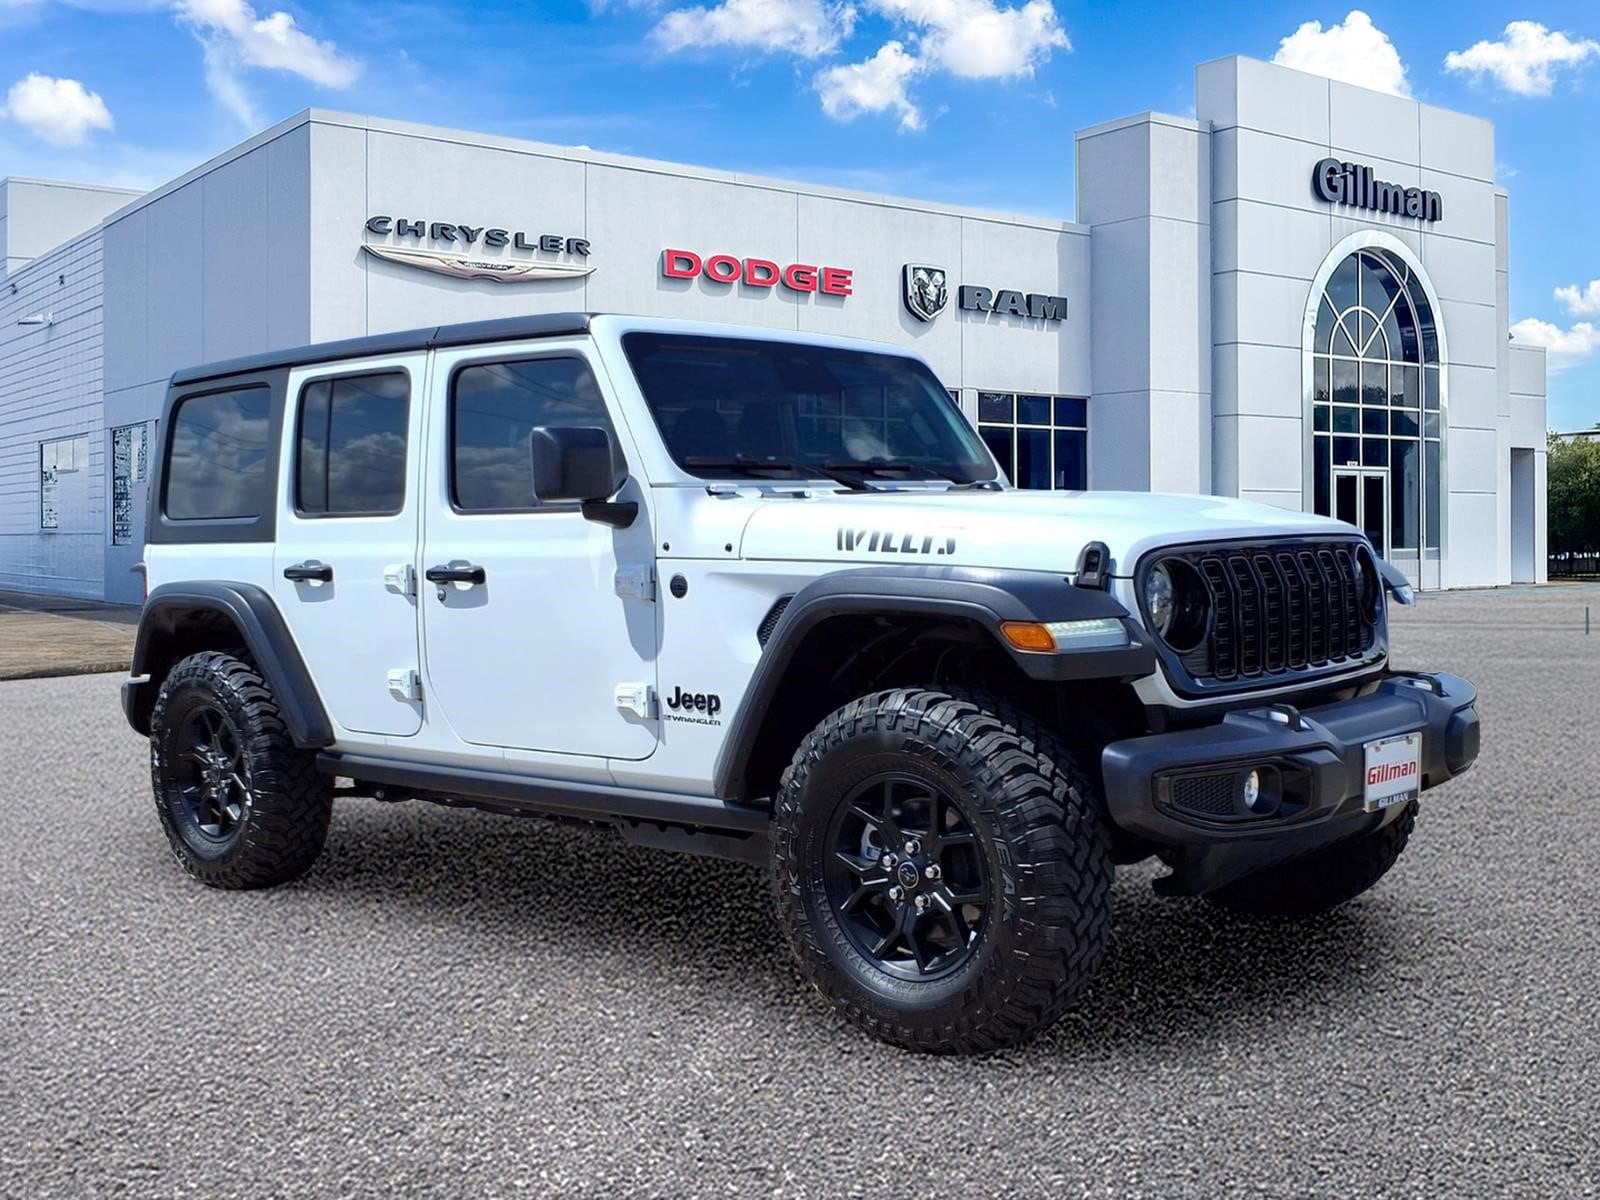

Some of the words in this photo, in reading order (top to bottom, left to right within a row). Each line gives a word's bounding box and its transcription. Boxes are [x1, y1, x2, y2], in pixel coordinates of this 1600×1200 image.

[1313, 157, 1443, 222] Gillman
[365, 215, 592, 256] CHRYSLER
[661, 248, 854, 296] DODGE
[958, 284, 1068, 321] RAM
[666, 685, 721, 717] Jeep
[671, 714, 721, 727] WRANGLER
[1367, 761, 1417, 786] Gillman
